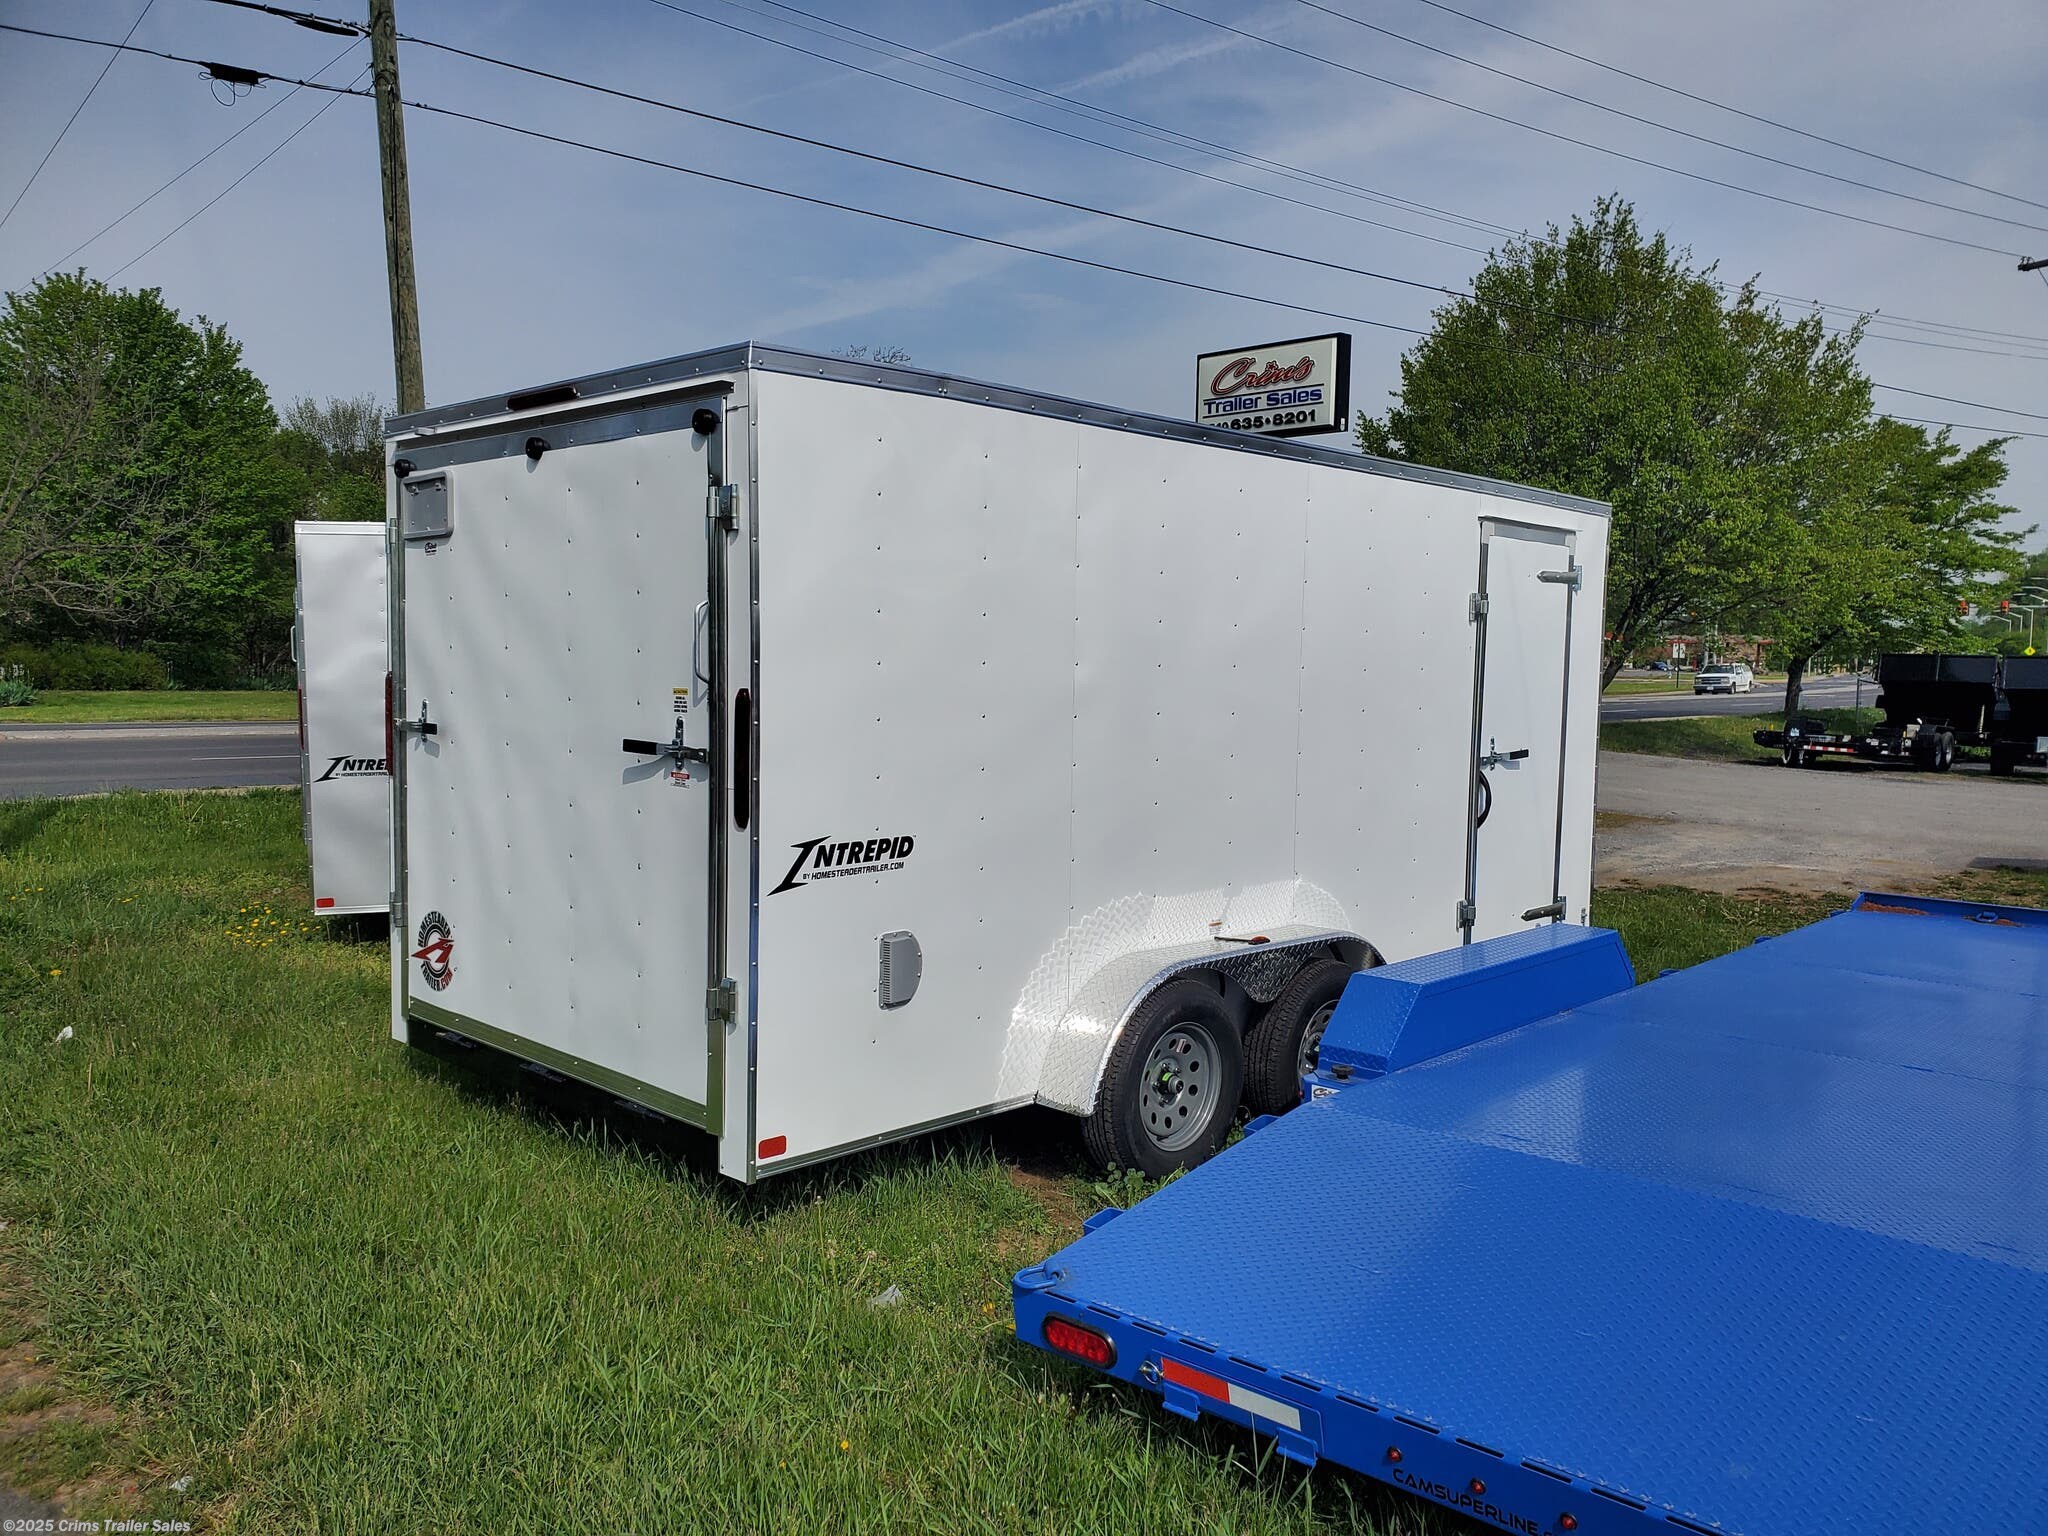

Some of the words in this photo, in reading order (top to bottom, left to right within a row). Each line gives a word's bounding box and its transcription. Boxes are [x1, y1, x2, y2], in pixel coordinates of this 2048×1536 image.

[1203, 398, 1262, 415] Trailer
[1266, 388, 1322, 407] Sales
[312, 754, 387, 783] INTRE
[766, 835, 915, 897] INTREPID
[811, 862, 905, 880] HOMESTEADERTRAILER.COM
[416, 911, 451, 948] HOMESTEADER
